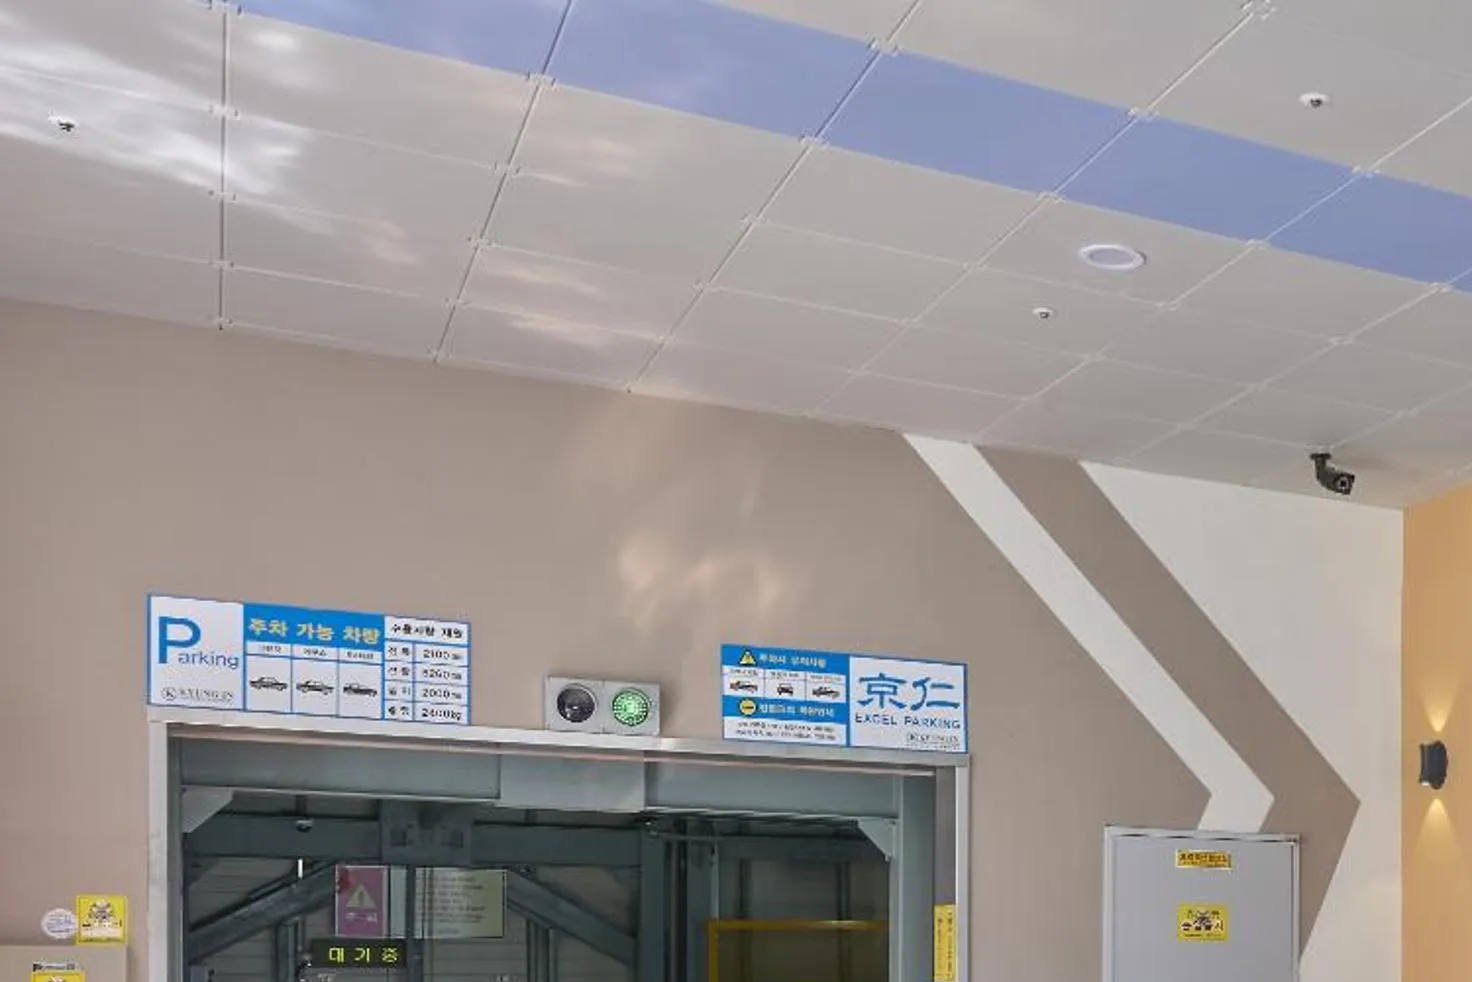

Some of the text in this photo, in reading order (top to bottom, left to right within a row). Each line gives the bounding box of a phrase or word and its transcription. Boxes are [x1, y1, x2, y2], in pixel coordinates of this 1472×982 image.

[158, 616, 239, 670] Parking
[249, 618, 381, 645] 주차 가능 차량
[855, 711, 961, 729] EXCEL PARKING
